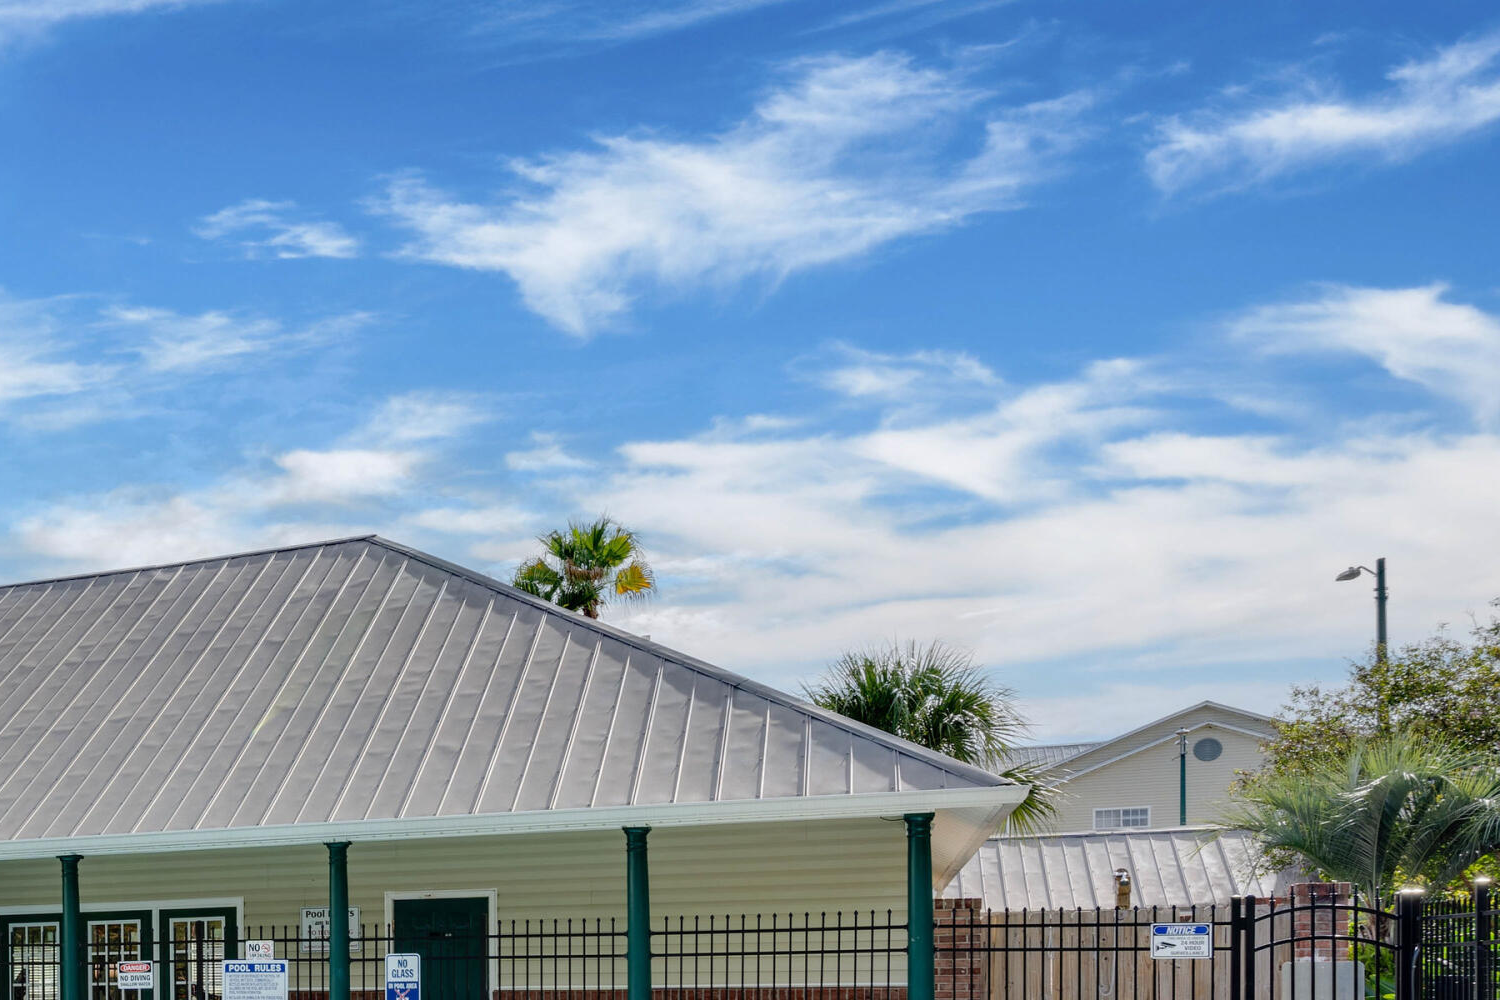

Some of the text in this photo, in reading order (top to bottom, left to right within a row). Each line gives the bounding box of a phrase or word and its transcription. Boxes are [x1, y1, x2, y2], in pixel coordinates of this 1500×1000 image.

[305, 910, 325, 918] Pool
[1166, 926, 1197, 935] NOTICE
[228, 964, 282, 972] POOL RULES
[398, 960, 408, 968] NO
[391, 969, 414, 978] GLASS
